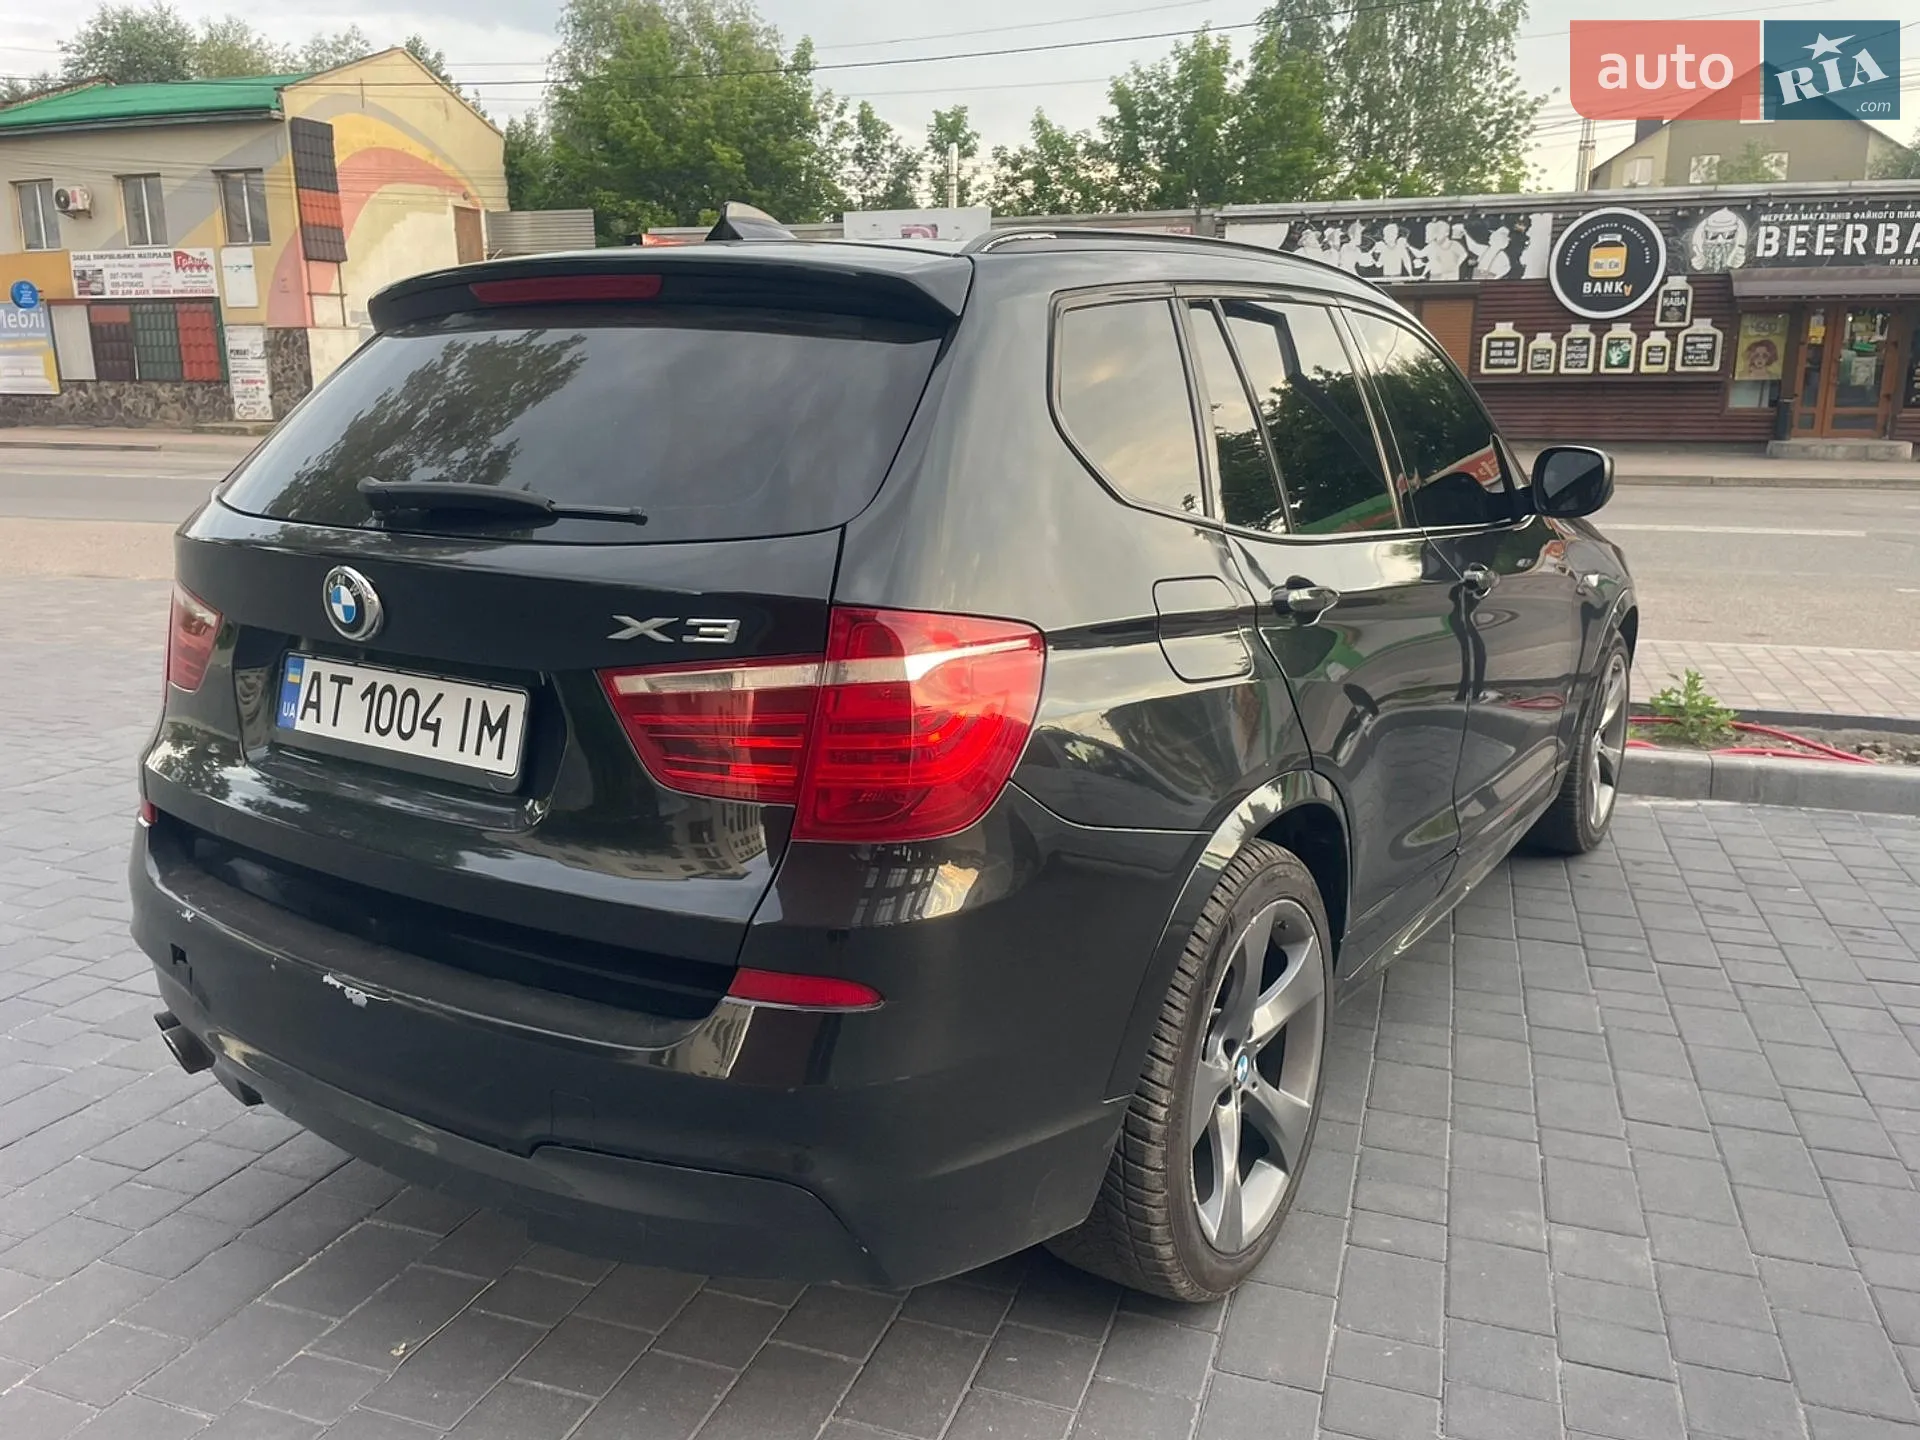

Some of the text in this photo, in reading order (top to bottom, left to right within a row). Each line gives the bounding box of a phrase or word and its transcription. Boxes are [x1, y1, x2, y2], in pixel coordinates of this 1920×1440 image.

[1760, 214, 1799, 222] МЕРЕЖА
[1853, 210, 1895, 219] ФАЙНОГО
[606, 614, 741, 644] X3
[282, 701, 296, 717] UA
[300, 671, 511, 761] AT 1004 IM
